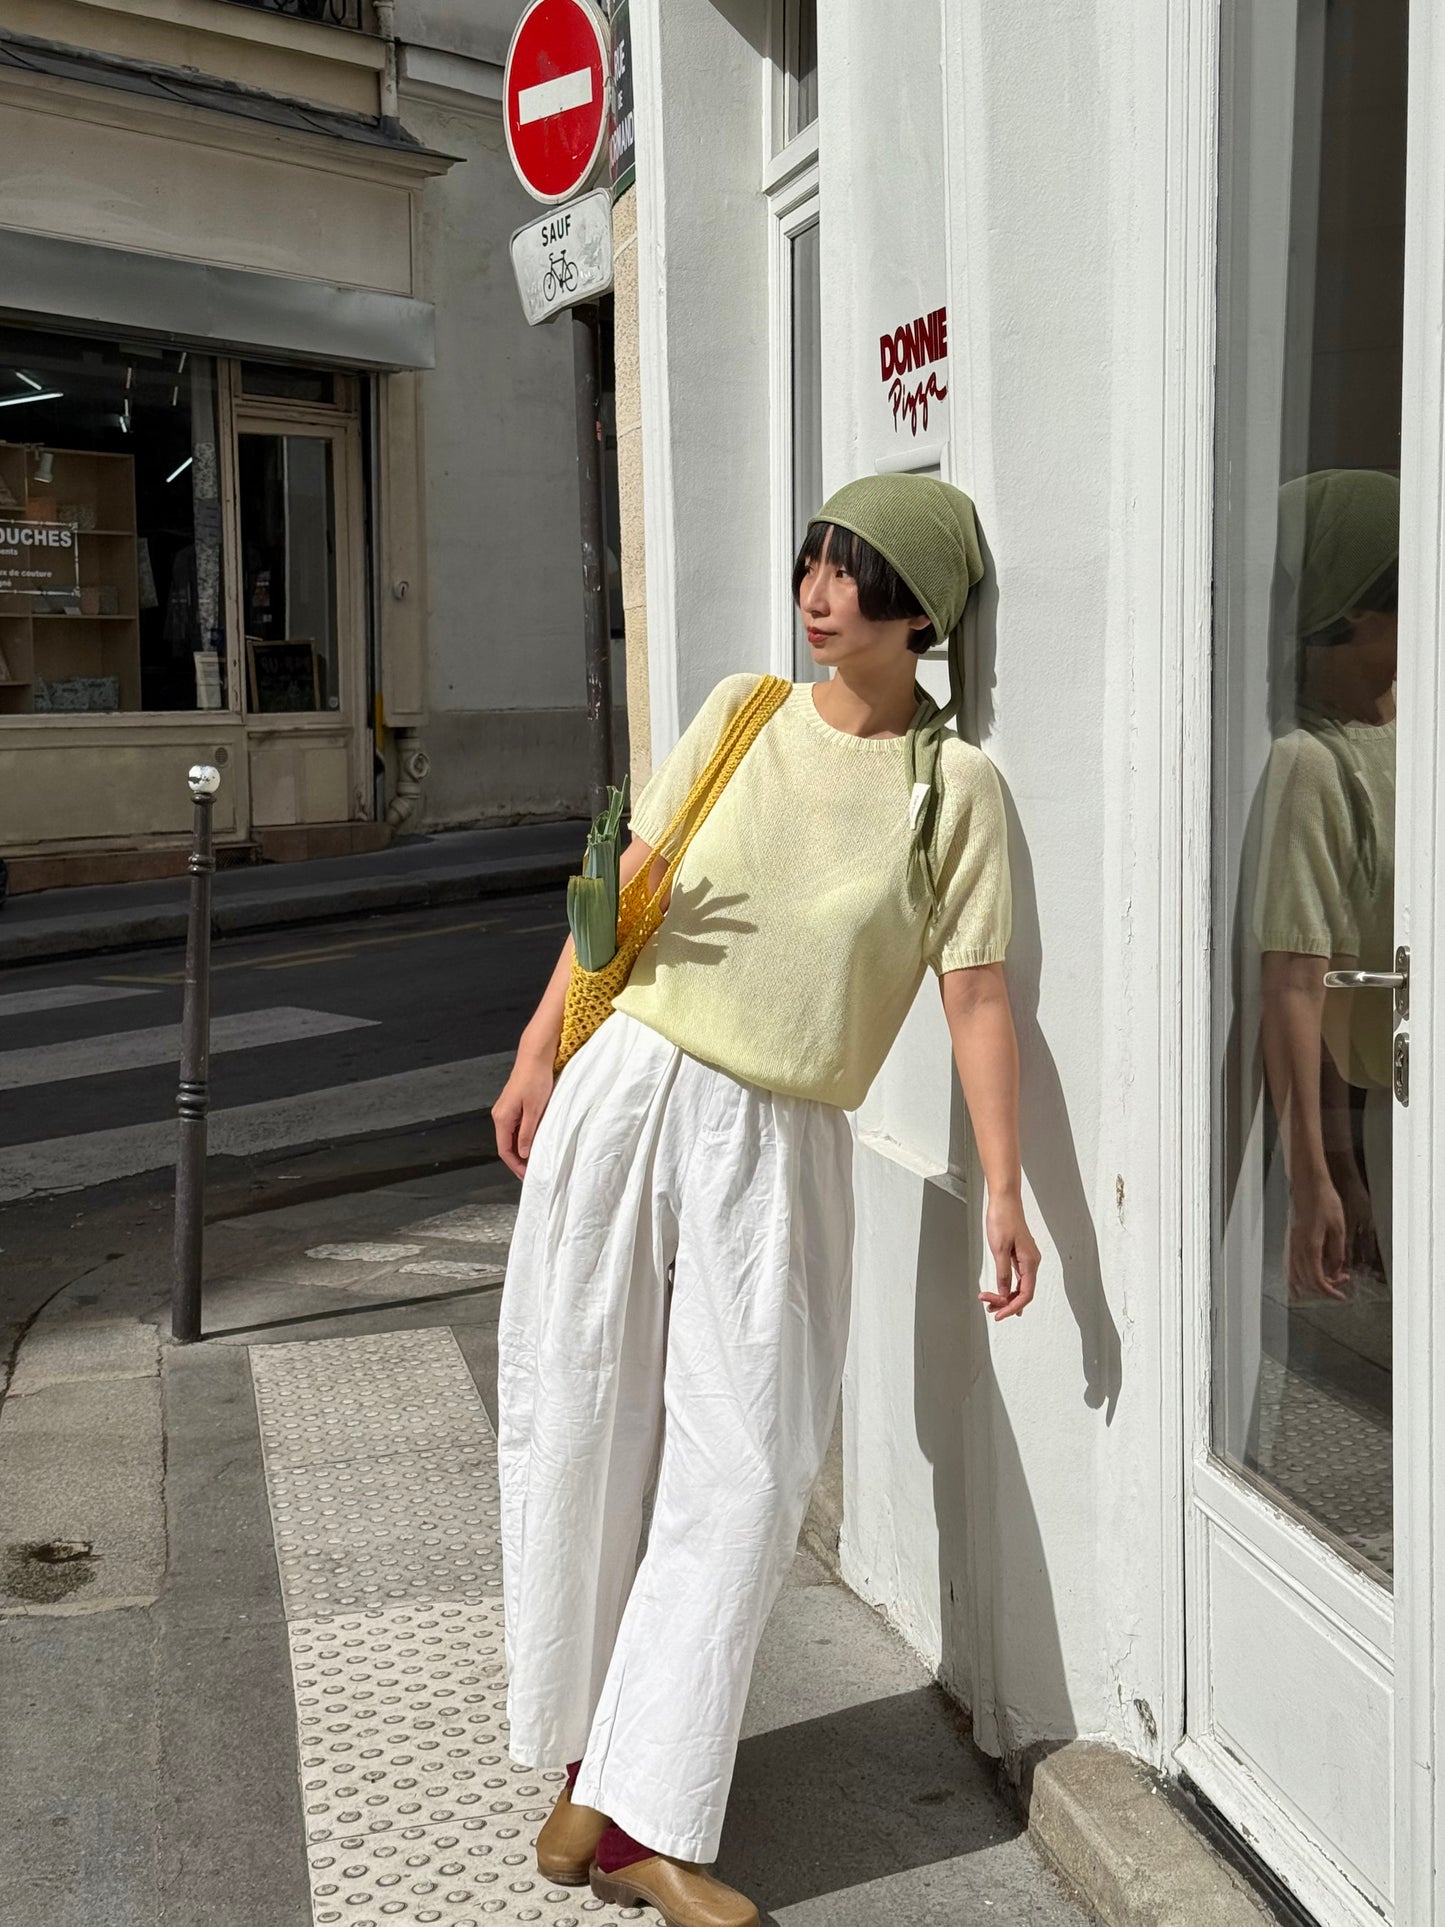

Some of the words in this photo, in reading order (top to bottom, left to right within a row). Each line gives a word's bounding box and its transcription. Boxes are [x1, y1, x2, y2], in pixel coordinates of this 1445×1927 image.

[541, 214, 571, 247] SAUF
[880, 306, 948, 382] DONNIE
[888, 371, 948, 437] Pizza
[21, 570, 53, 578] couture
